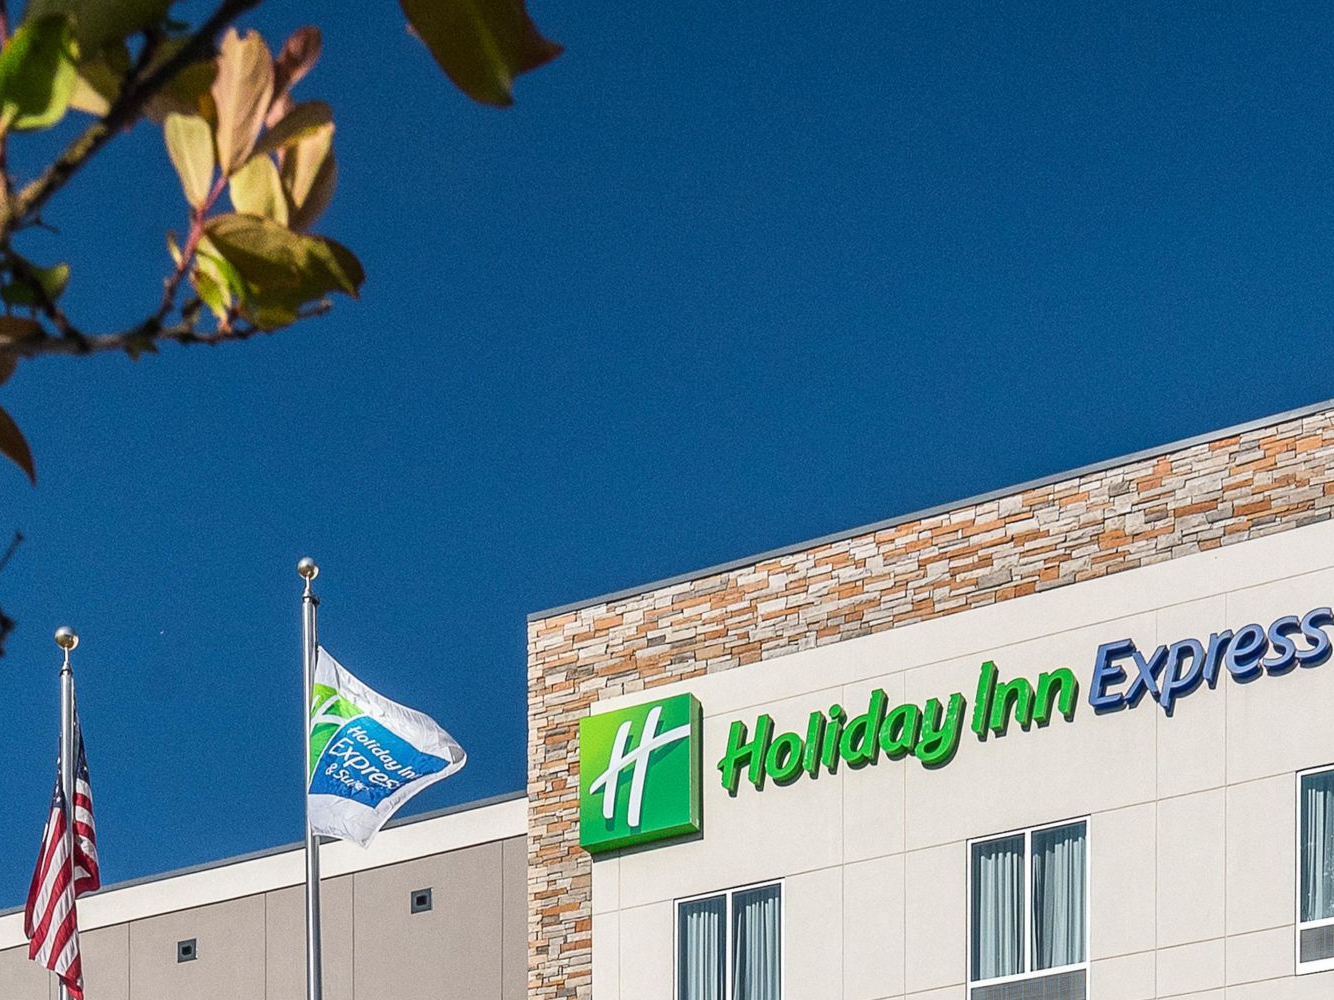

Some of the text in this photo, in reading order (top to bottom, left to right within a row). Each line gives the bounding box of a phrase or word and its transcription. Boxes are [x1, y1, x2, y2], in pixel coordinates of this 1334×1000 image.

[347, 726, 402, 770] Holiday
[717, 688, 966, 794] Holiday
[971, 660, 1079, 741] Inn
[329, 738, 405, 790] Expres
